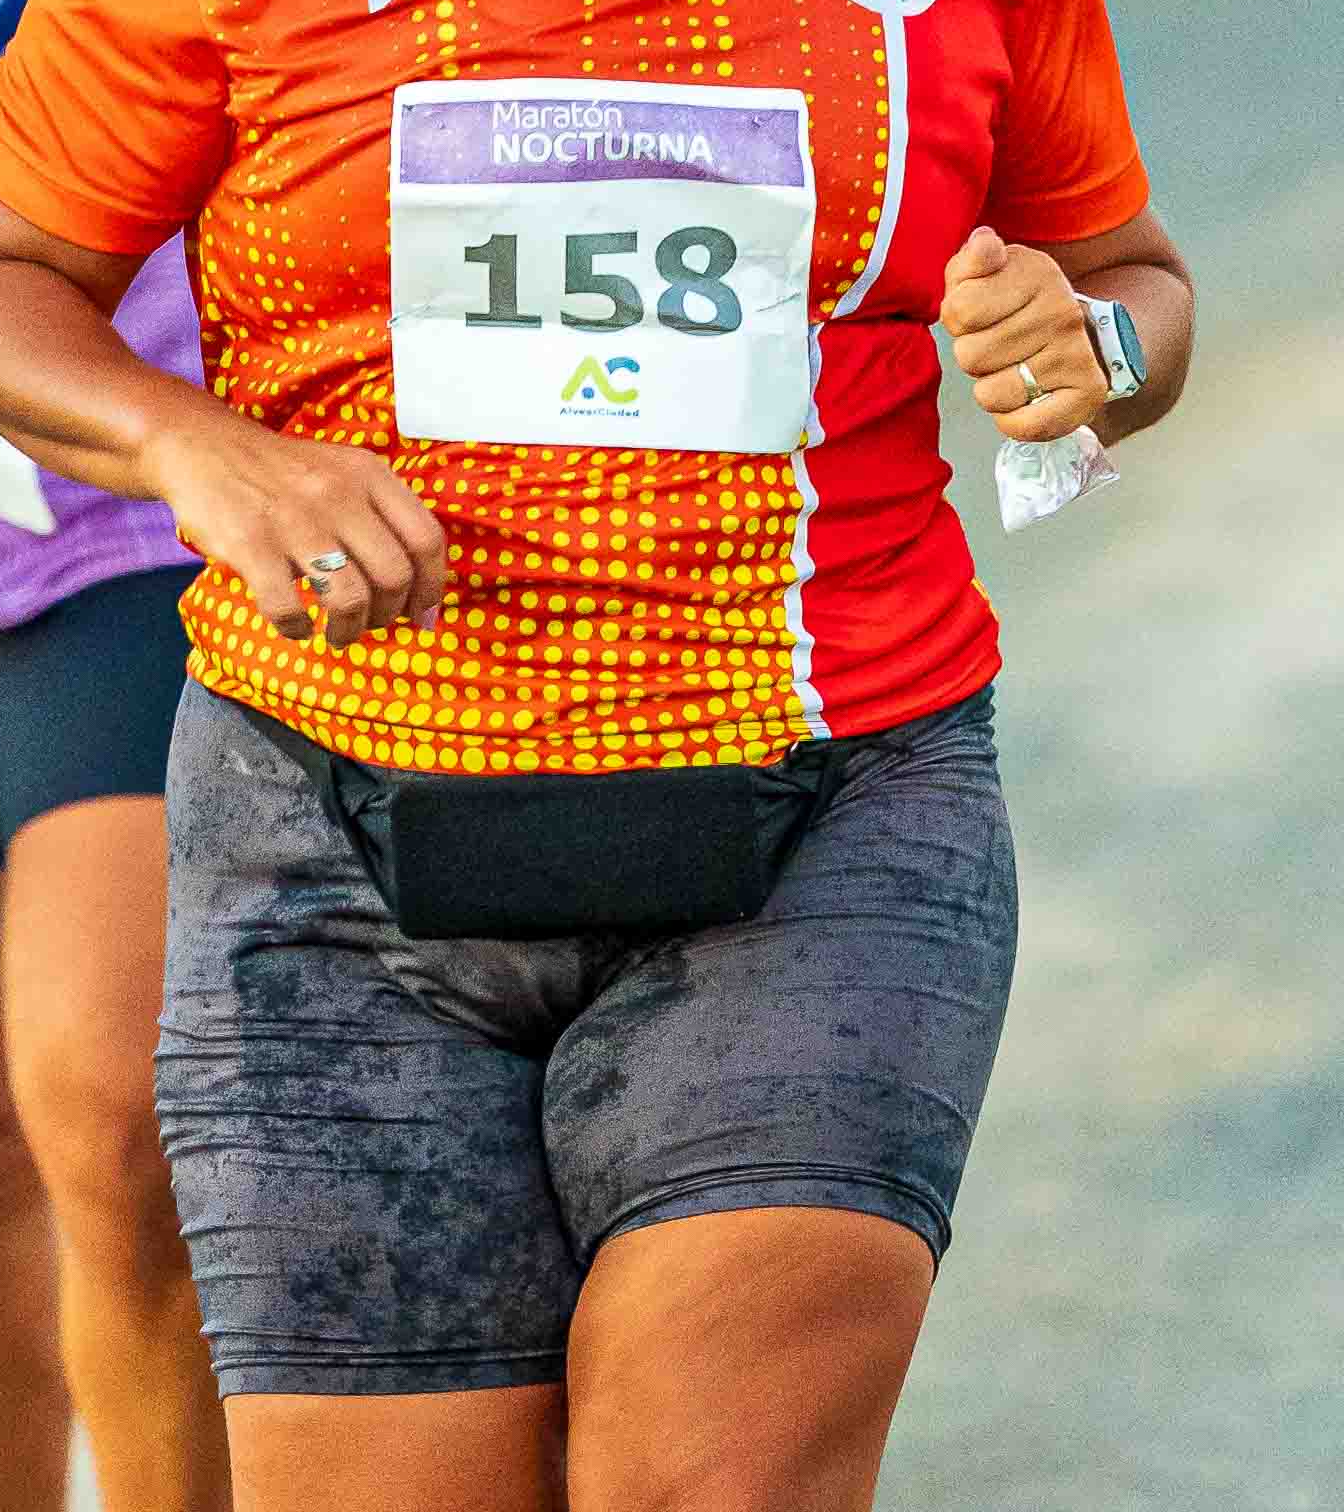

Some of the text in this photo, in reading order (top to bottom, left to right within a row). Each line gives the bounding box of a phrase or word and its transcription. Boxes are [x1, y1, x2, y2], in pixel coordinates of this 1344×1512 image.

[492, 99, 623, 129] Maratón
[493, 131, 714, 164] NOCTURNA
[464, 225, 743, 337] 158
